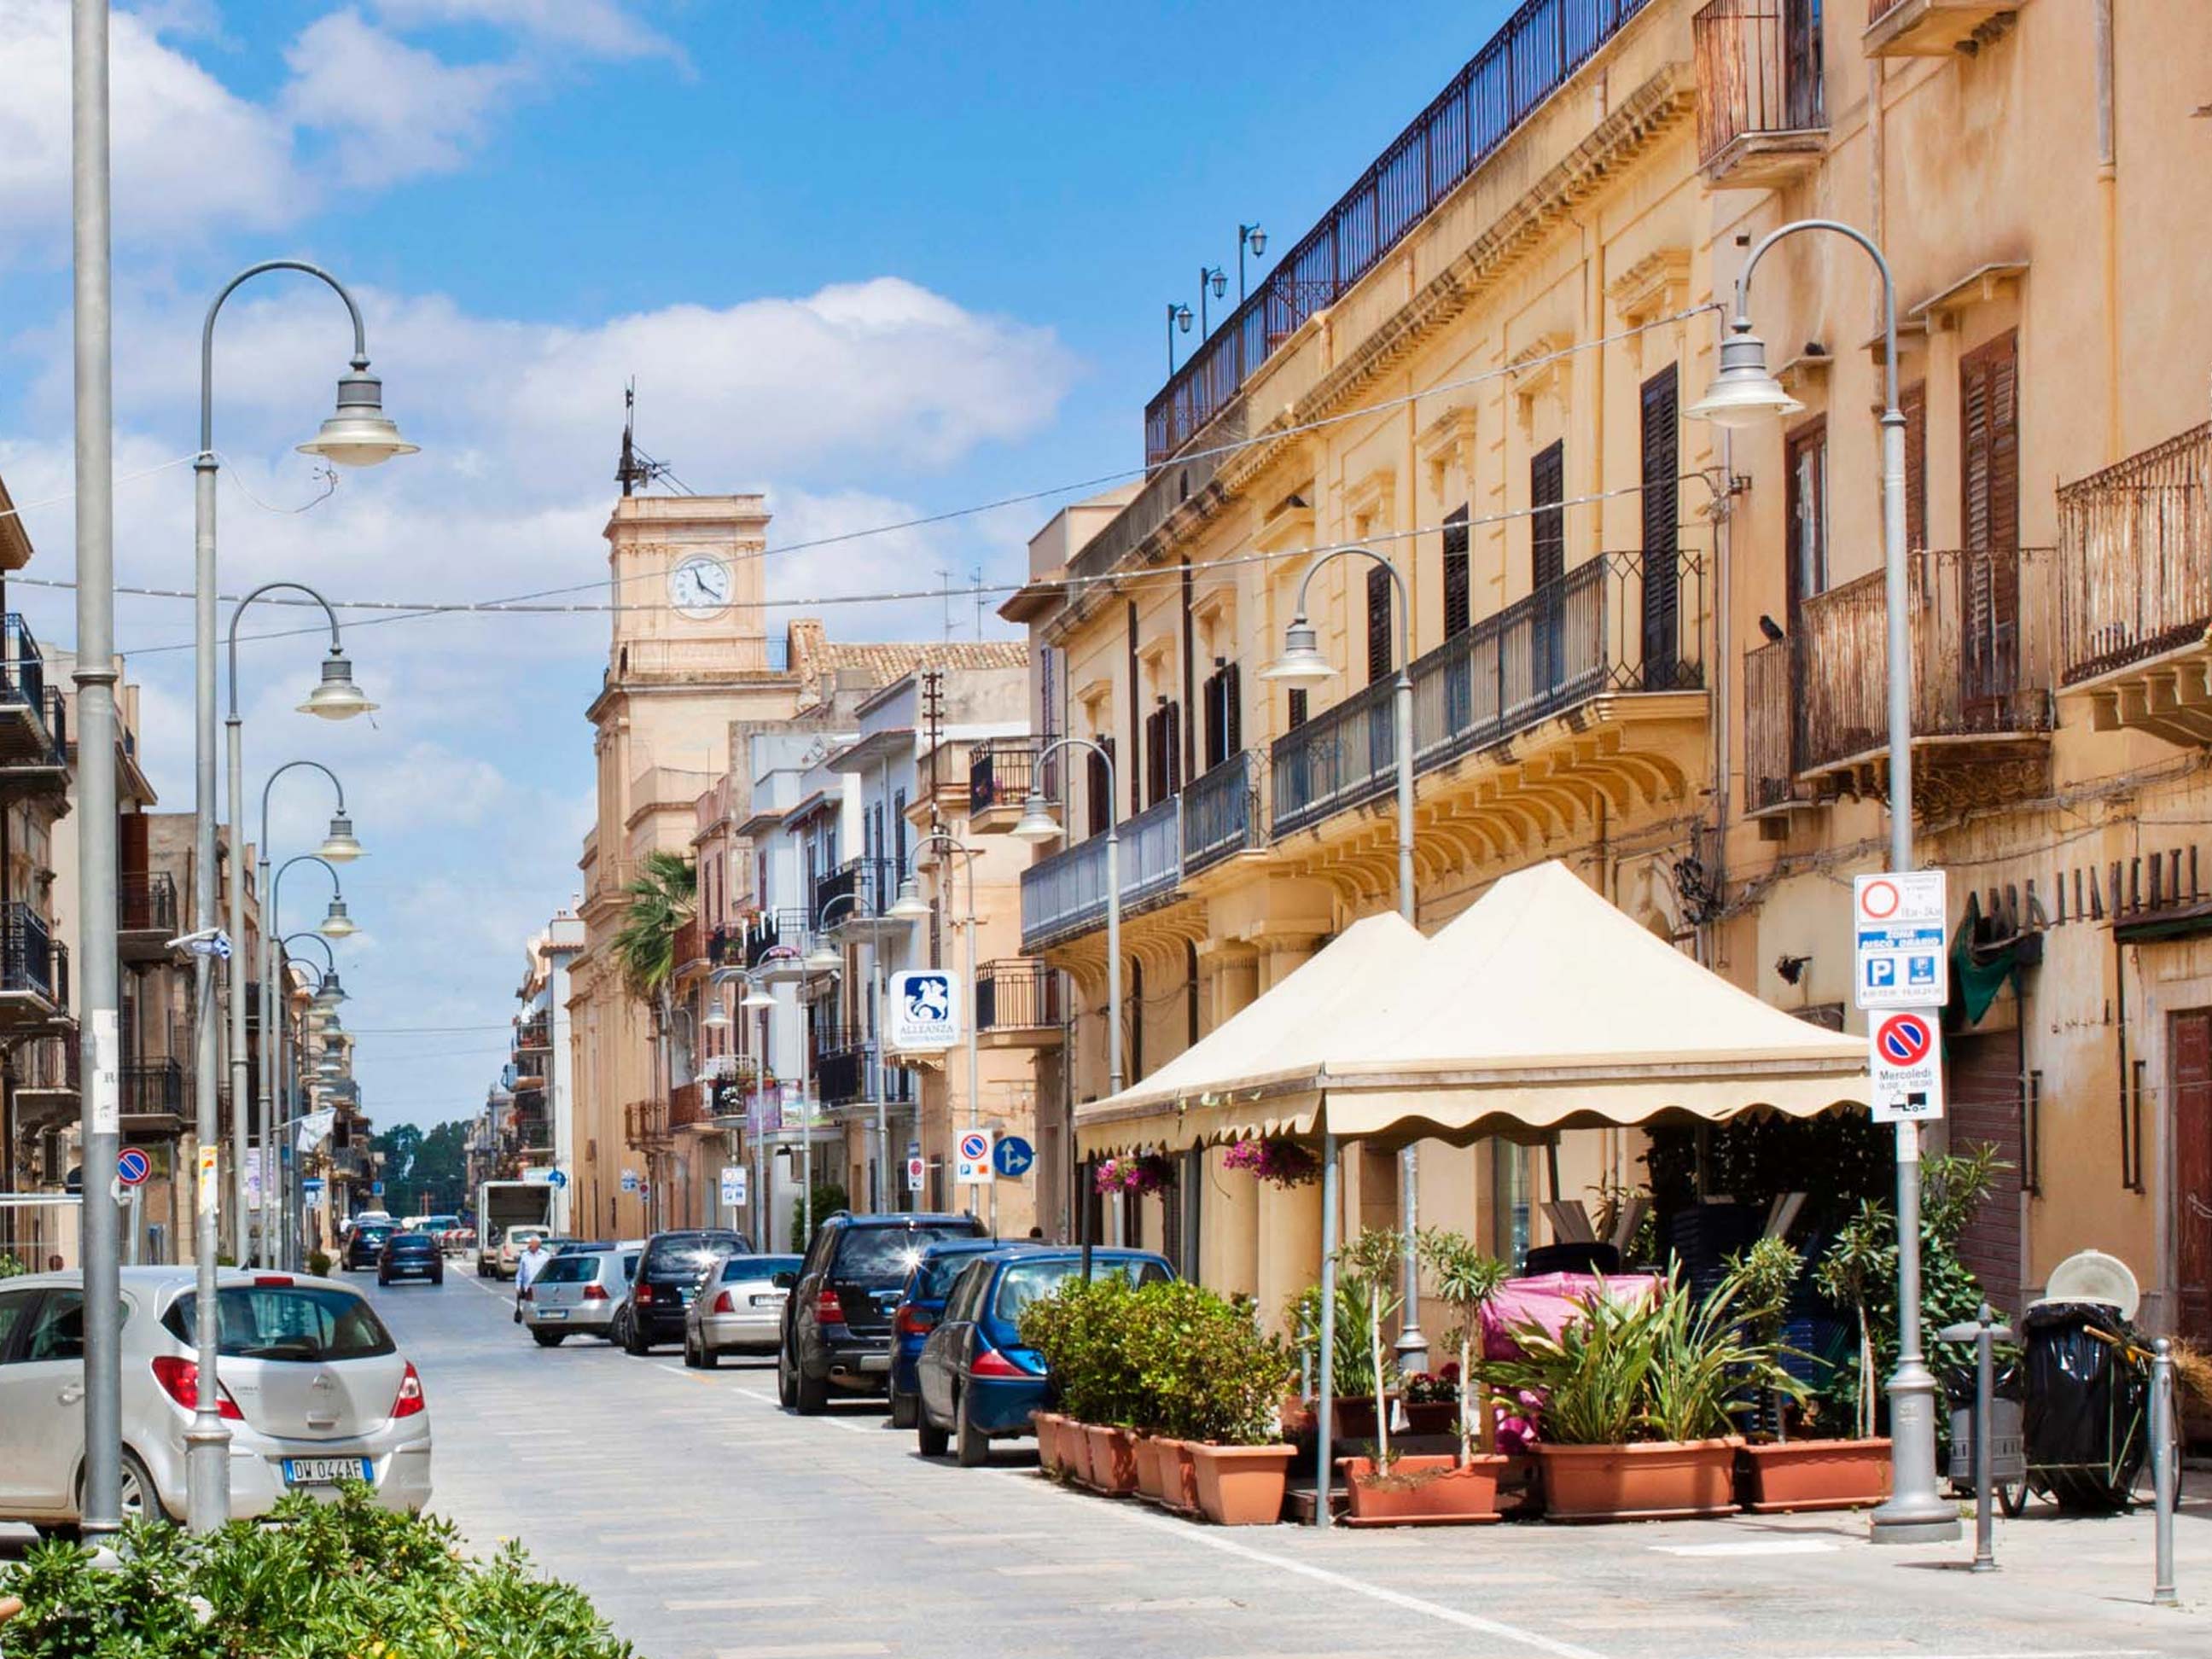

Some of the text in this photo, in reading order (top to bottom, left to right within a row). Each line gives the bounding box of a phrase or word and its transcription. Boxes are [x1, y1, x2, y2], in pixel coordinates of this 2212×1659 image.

[1872, 961, 1889, 984] P
[901, 1025, 953, 1033] ALLEANZA
[294, 1460, 361, 1479] DW 044AF
